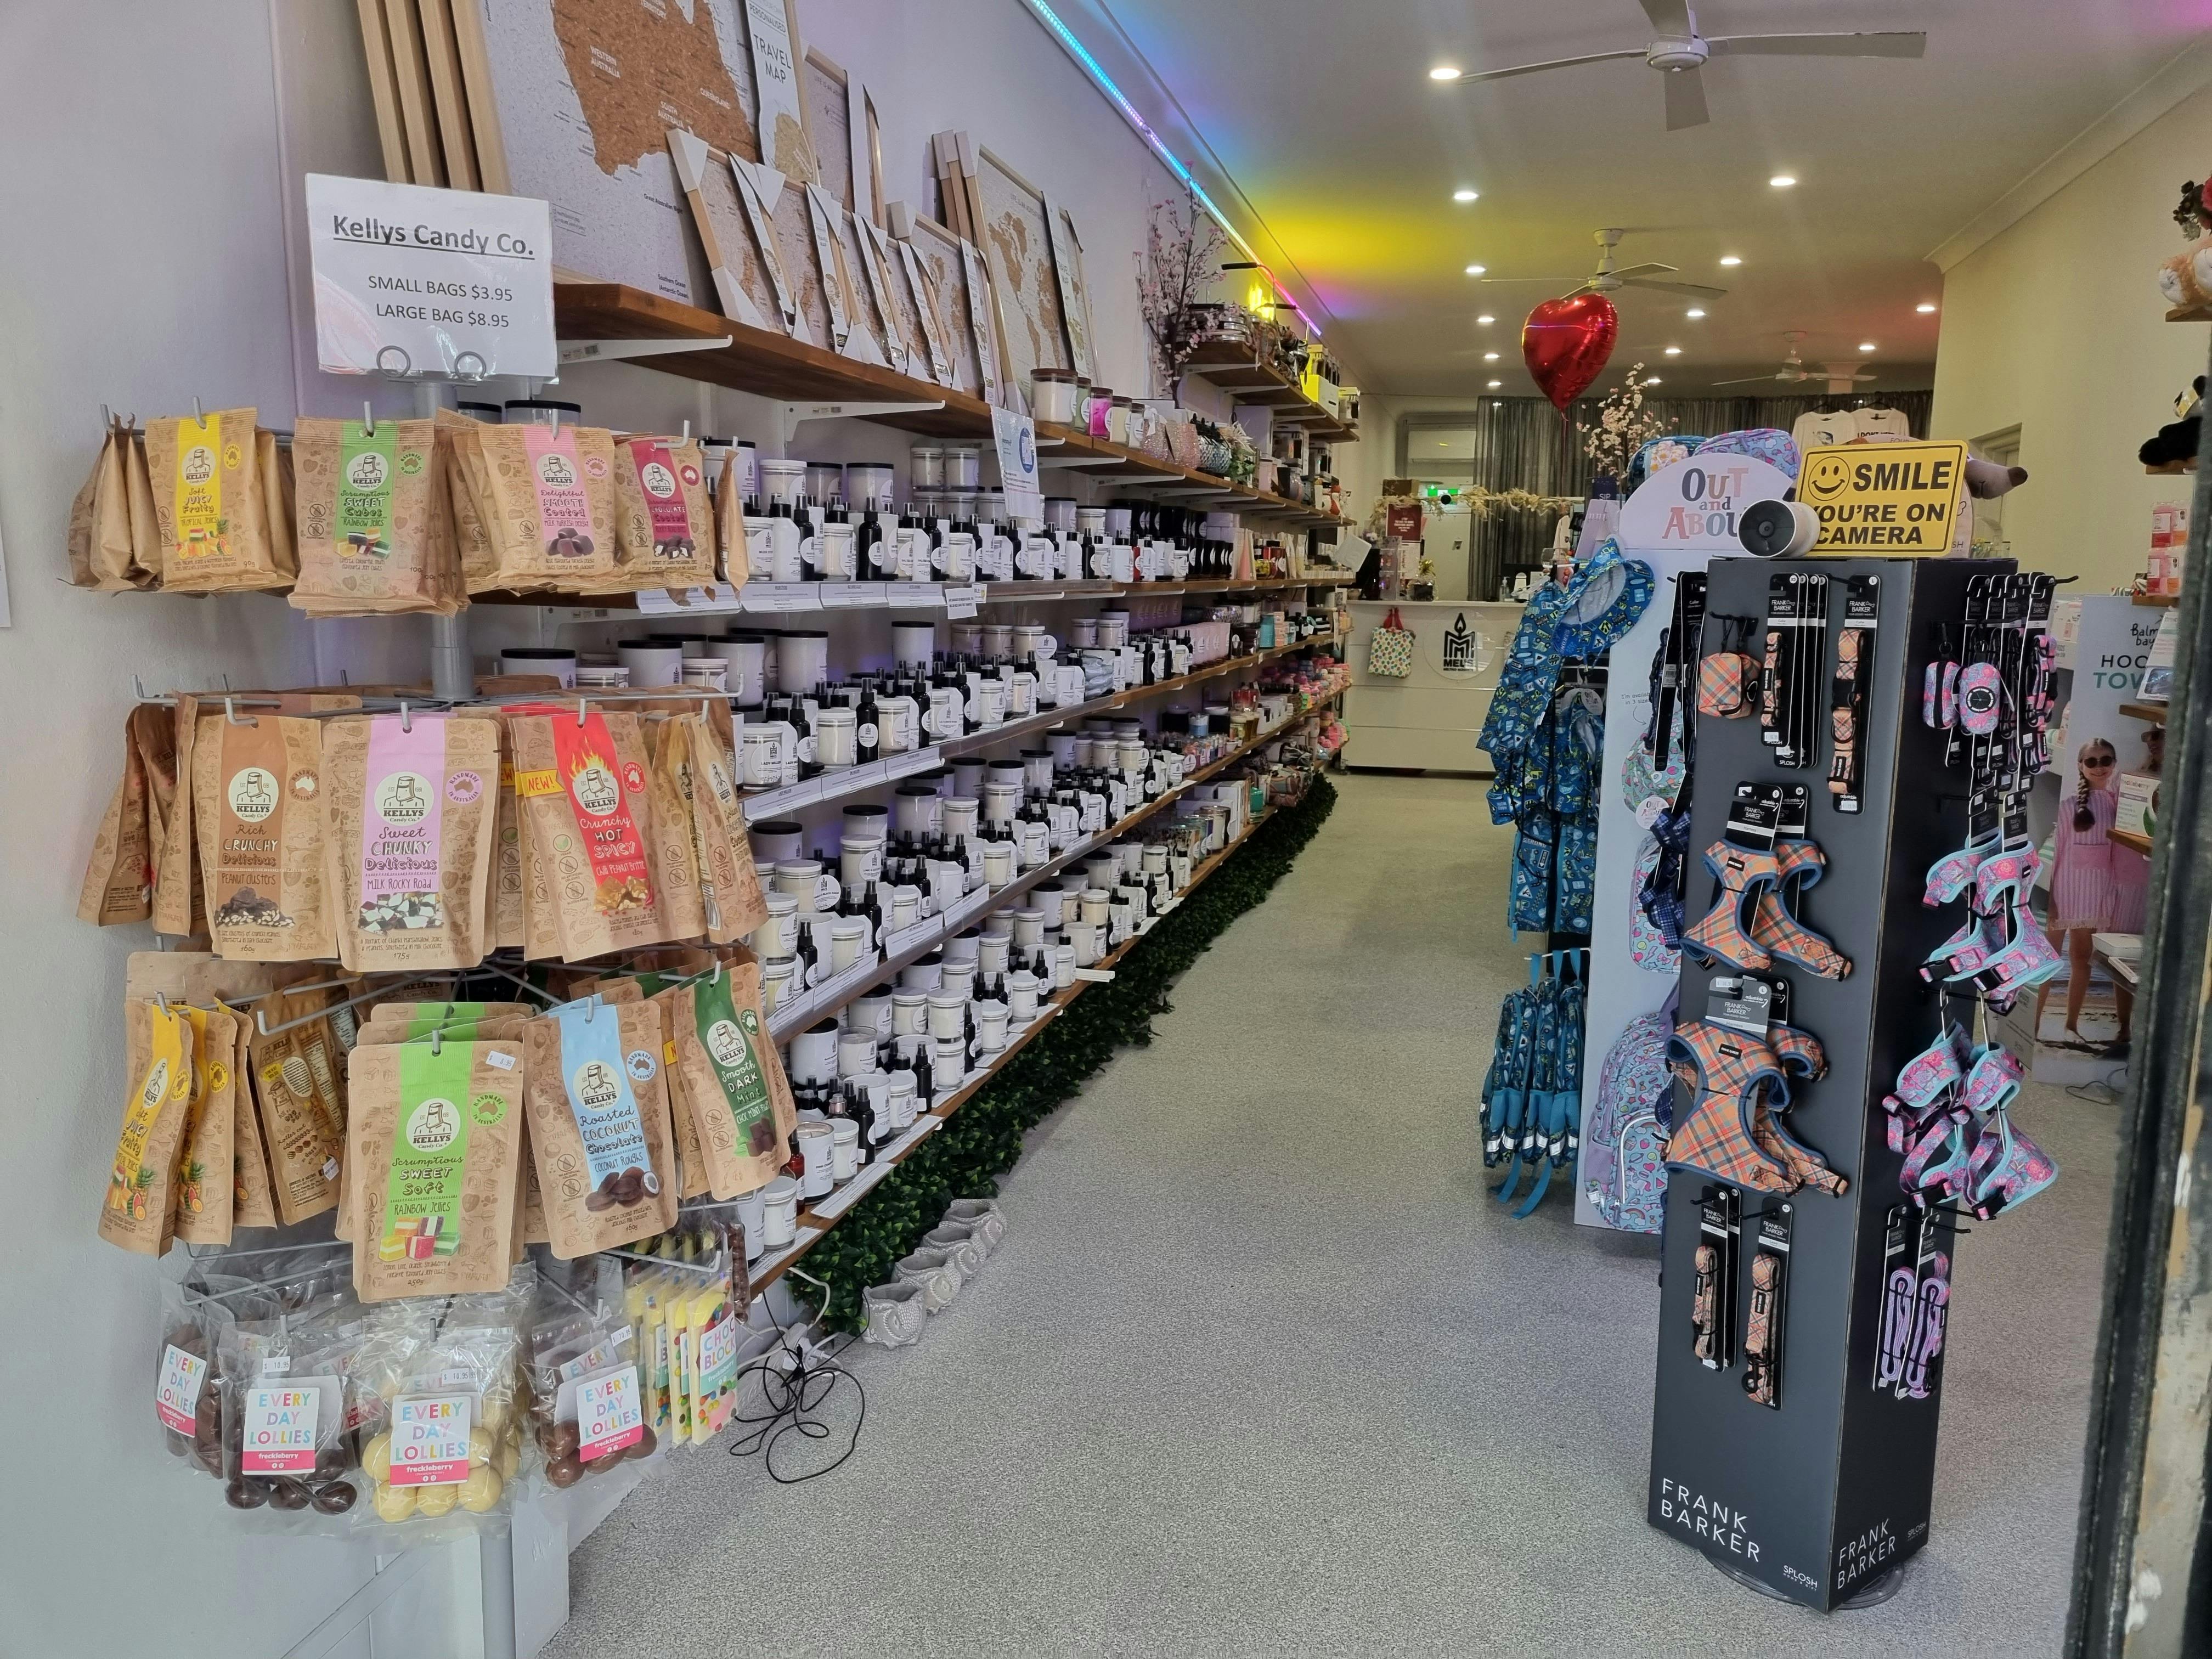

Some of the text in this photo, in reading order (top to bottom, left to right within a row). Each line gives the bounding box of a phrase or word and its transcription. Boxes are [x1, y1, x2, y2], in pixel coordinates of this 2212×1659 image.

[750, 3, 786, 33] PERSONALISED
[590, 45, 617, 66] WESTERN
[754, 34, 791, 69] TRAVEL
[591, 57, 620, 79] AUSTRALIA
[765, 61, 786, 83] MAP
[660, 101, 678, 115] SOUTH
[334, 216, 533, 256] Kellys Candy Co.
[369, 276, 512, 302] SMALL BAGS $3.95
[376, 303, 509, 328] LARGE BAG $8.95
[1853, 461, 1952, 492] SMILE
[184, 495, 212, 504] JUICY
[344, 498, 386, 507] SWEET
[543, 499, 583, 507] SMOOTH
[1699, 496, 1731, 510] and
[183, 505, 214, 514] Fruity
[345, 507, 382, 517] Cubes
[544, 507, 585, 517] Coated
[1906, 503, 1945, 522] ON
[343, 518, 368, 527] RAINBOW
[1663, 507, 1737, 539] ABOU
[1816, 527, 1922, 544] CAMERA
[2130, 623, 2159, 637] Balm
[1443, 659, 1473, 667] MEL'S
[2101, 654, 2148, 668] HOO
[450, 772, 479, 784] HANDMADE
[528, 776, 554, 792] NEW!
[584, 799, 617, 809] KELLYS
[580, 815, 631, 829] Crunchy
[236, 825, 267, 835] Rich
[379, 826, 426, 839] Sweet
[595, 828, 623, 842] HOT
[223, 838, 278, 851] CRUNCHY
[371, 841, 432, 856] CHUNKY
[594, 841, 635, 859] SPICY
[222, 853, 276, 867] Delicious
[365, 857, 437, 871] Delicious
[610, 863, 629, 874] PEANUT
[222, 873, 245, 884] PEANUT
[368, 879, 385, 890] MILK
[388, 878, 410, 889] ROCKY
[240, 945, 255, 953] 160g
[1724, 1001, 1742, 1009] FRANK
[1726, 1007, 1746, 1015] BARKER
[628, 1051, 651, 1064] HANDMADE
[719, 1048, 745, 1062] KELLYS
[722, 1060, 756, 1082] Smooth
[728, 1072, 758, 1093] DARK
[473, 1094, 504, 1107] HANDMADE
[584, 1092, 617, 1105] KELLYS
[736, 1086, 761, 1104] Mint
[579, 1105, 635, 1127] Roasted
[126, 1116, 149, 1139] JUICY
[583, 1118, 640, 1142] COCONUT
[413, 1135, 451, 1144] KELLYS
[586, 1134, 643, 1155] Chocolate
[392, 1156, 464, 1167] Scrumptious
[595, 1160, 619, 1173] COCONUT
[399, 1166, 453, 1180] SWEET
[403, 1181, 444, 1196] Soft
[394, 1203, 427, 1216] RAINBOW
[1703, 1207, 1717, 1216] FRANK
[1706, 1213, 1722, 1223] BARKER
[1763, 1221, 1779, 1229] FRANK
[1765, 1227, 1783, 1236] BARKER
[618, 1329, 631, 1340] 10.95
[704, 1317, 734, 1351] CHOC
[704, 1338, 735, 1370] BLOCK
[169, 1351, 202, 1377] EVERY
[273, 1361, 289, 1369] 10.95
[570, 1346, 608, 1379] EVERY
[170, 1372, 190, 1392] DAY
[585, 1375, 630, 1403] EVERY
[159, 1386, 194, 1415] LOLLIES
[259, 1392, 312, 1407] EVERY
[596, 1395, 624, 1417] DAY
[162, 1406, 185, 1423] freckleberry
[267, 1411, 301, 1426] DAY
[402, 1402, 464, 1421] EVERY
[585, 1407, 639, 1439] LOLLIES
[250, 1430, 311, 1444] LOLLIES
[412, 1423, 451, 1440] DAY
[594, 1432, 630, 1448] freckleberry
[395, 1441, 467, 1462] LOLLIES
[406, 1464, 453, 1472] freckleberry
[1662, 1478, 1748, 1533] FRANK
[1661, 1499, 1760, 1563] BARKER
[1907, 1521, 1926, 1538] SPLOSH
[1839, 1517, 1890, 1567] FRANK
[1837, 1537, 1896, 1590] BARKER
[1784, 1565, 1818, 1588] SPLOSH
